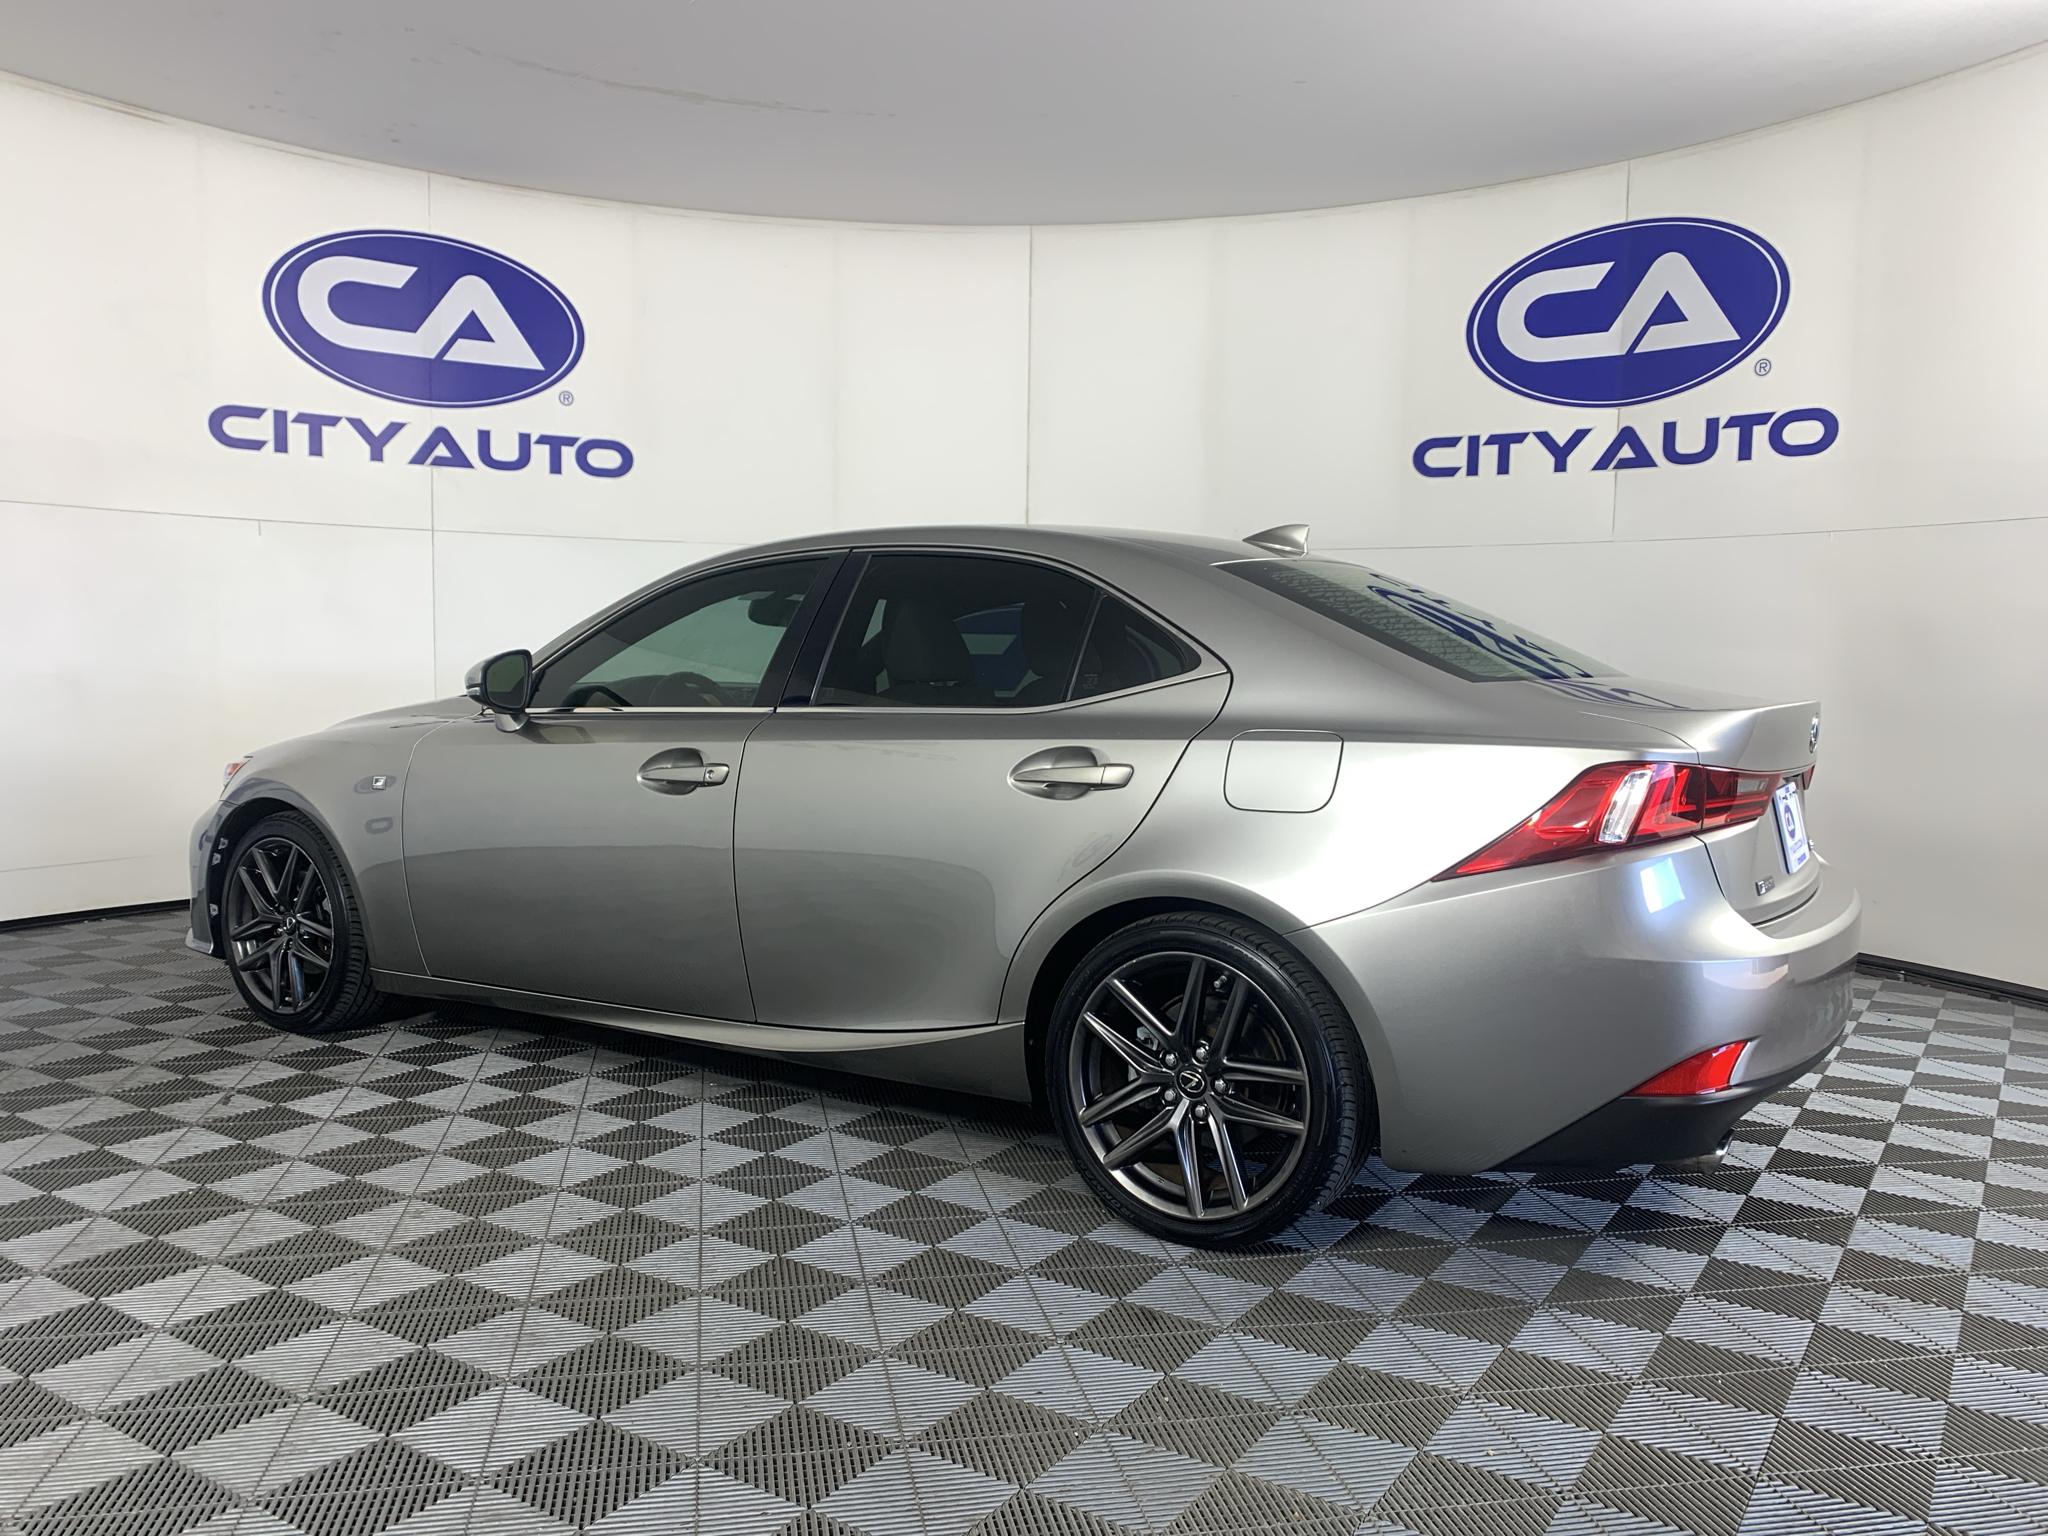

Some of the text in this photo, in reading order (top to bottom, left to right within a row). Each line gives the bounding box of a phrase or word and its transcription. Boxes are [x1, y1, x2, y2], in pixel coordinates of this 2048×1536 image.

[297, 254, 546, 371] CA
[1496, 251, 1742, 363] CA
[207, 404, 634, 479] CITY AUTO
[1412, 407, 1840, 478] CITY AUTO
[1077, 1159, 1136, 1219] IRONMAN
